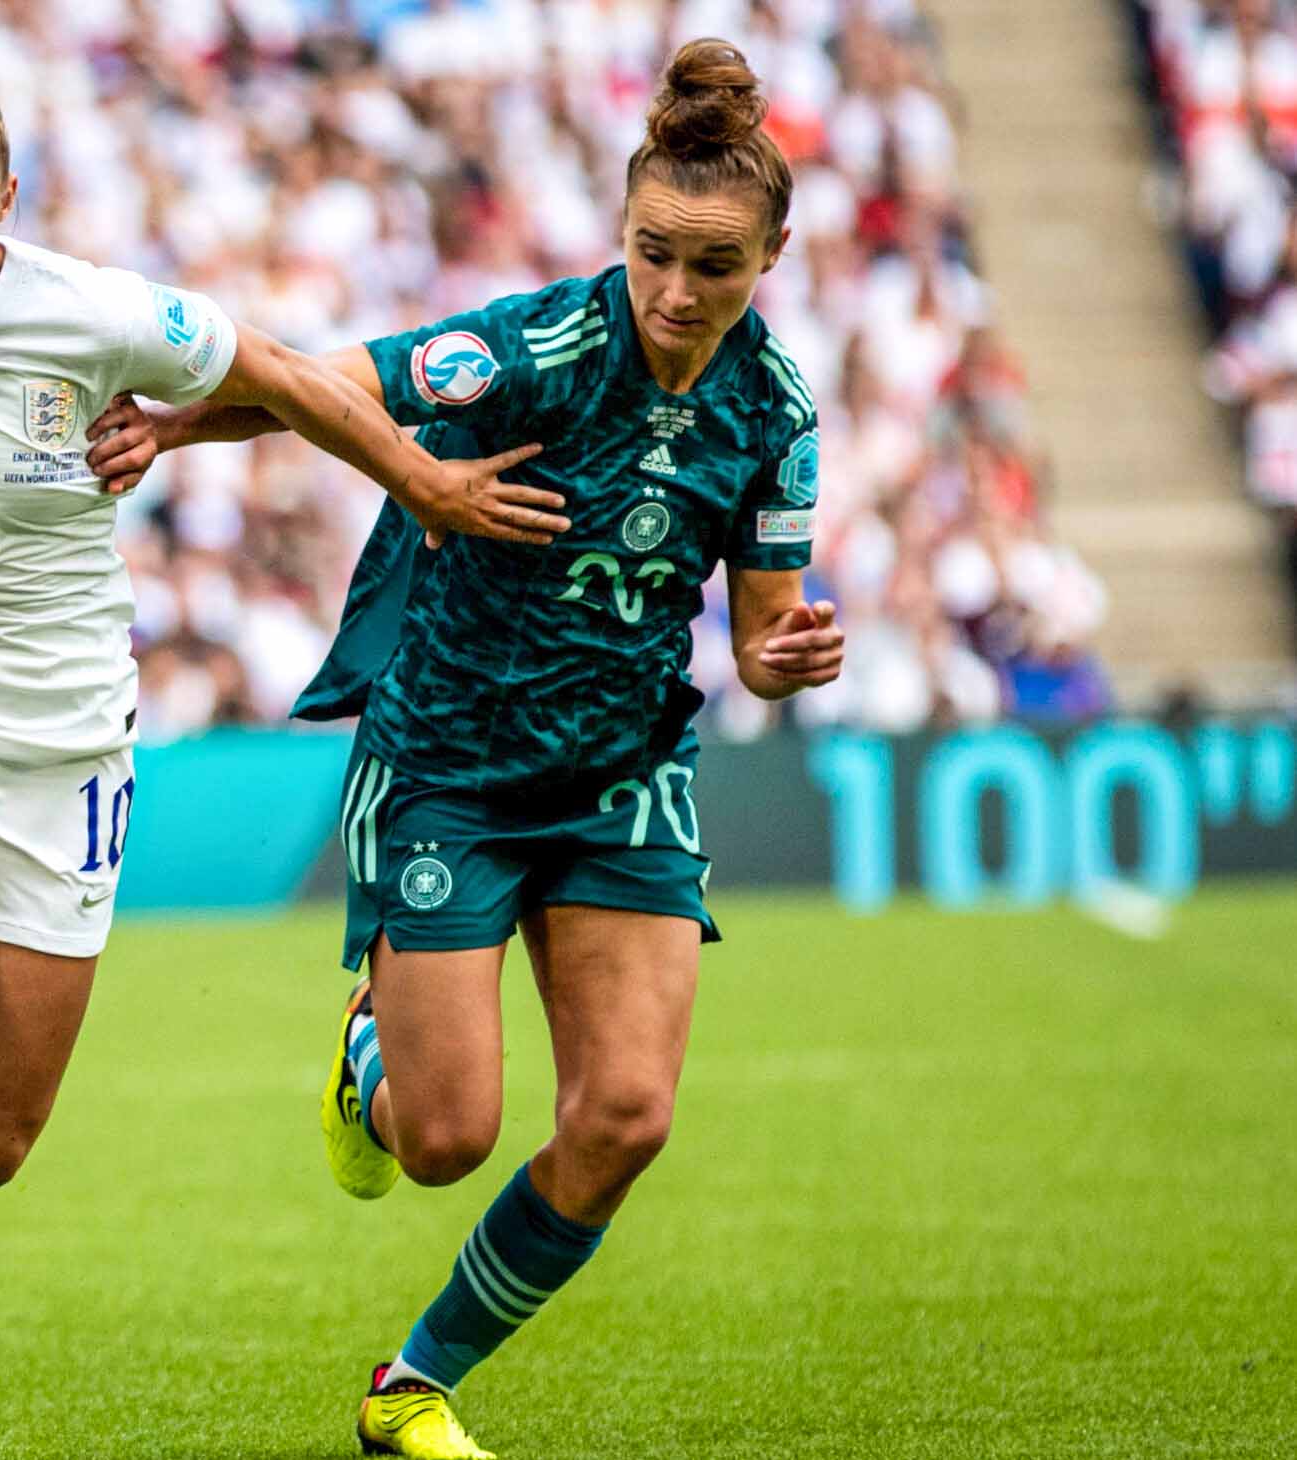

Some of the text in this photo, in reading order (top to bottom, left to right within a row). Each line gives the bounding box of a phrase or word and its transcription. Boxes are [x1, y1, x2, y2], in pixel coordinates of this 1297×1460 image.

[12, 451, 52, 463] ENGLAND
[639, 460, 677, 476] adidas
[3, 472, 26, 484] UEFA
[78, 774, 135, 872] 10
